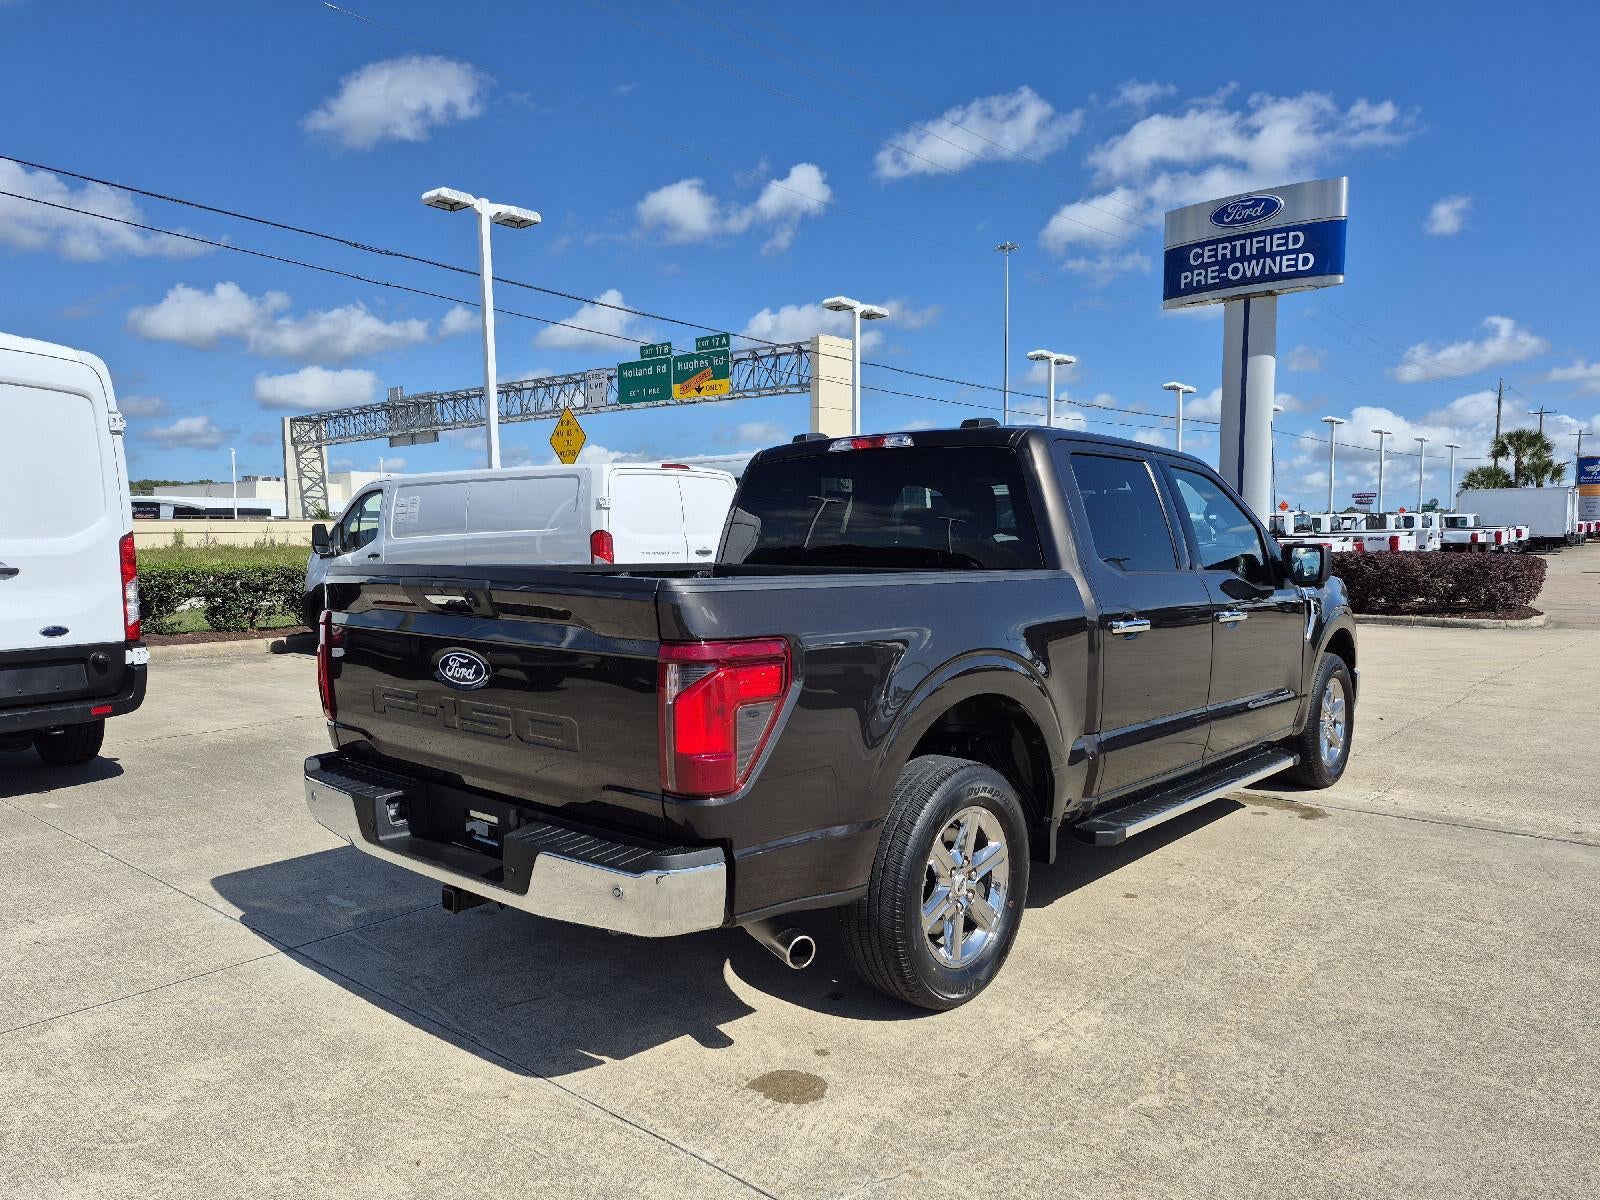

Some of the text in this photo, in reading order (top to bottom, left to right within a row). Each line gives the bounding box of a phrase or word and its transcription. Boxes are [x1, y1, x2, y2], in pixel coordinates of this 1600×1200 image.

[1223, 199, 1266, 223] Ford
[1189, 231, 1305, 266] CERTIFIED
[1180, 252, 1315, 290] PRE-OWNED
[655, 345, 662, 355] 17
[711, 337, 719, 346] 17
[721, 336, 727, 346] A
[622, 364, 667, 378] Holland Rd
[677, 355, 724, 372] Hughes Rd
[705, 383, 723, 392] ONLY
[445, 655, 477, 681] Ford
[371, 684, 581, 752] F-150
